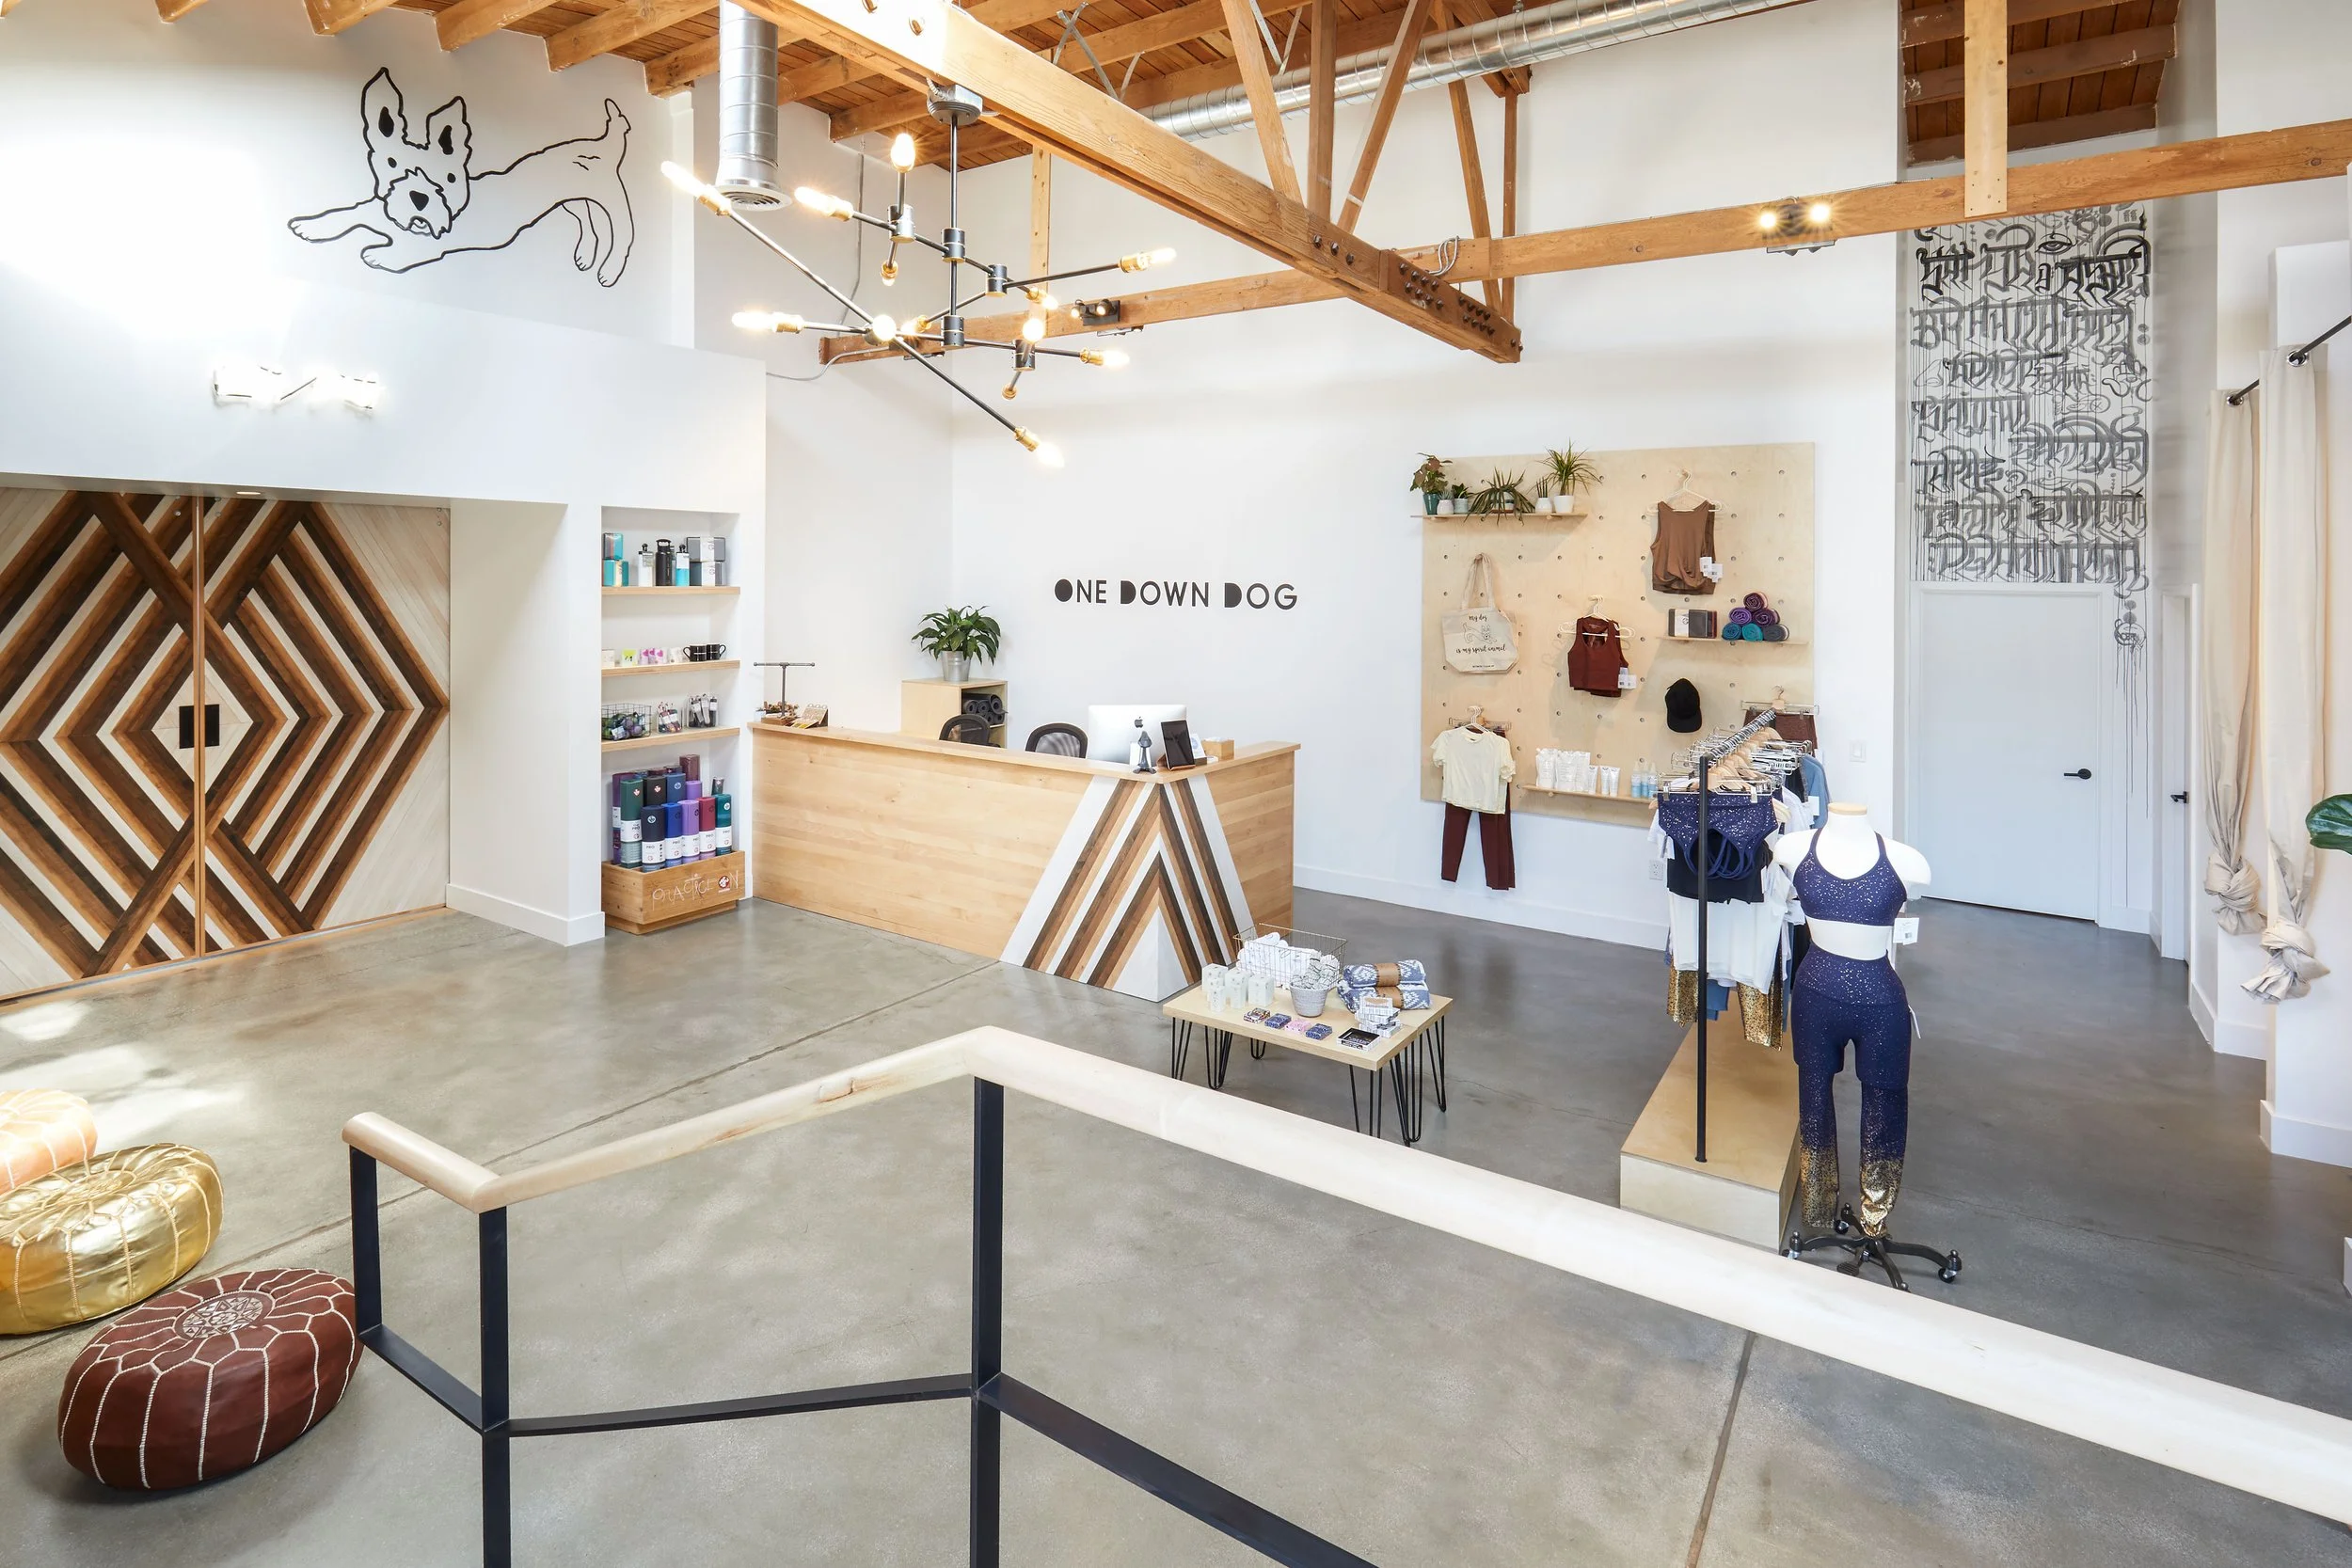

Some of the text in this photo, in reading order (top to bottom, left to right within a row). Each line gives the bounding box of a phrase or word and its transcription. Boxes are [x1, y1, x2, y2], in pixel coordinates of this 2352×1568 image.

[1055, 578, 1298, 610] ONE DOWN DOG
